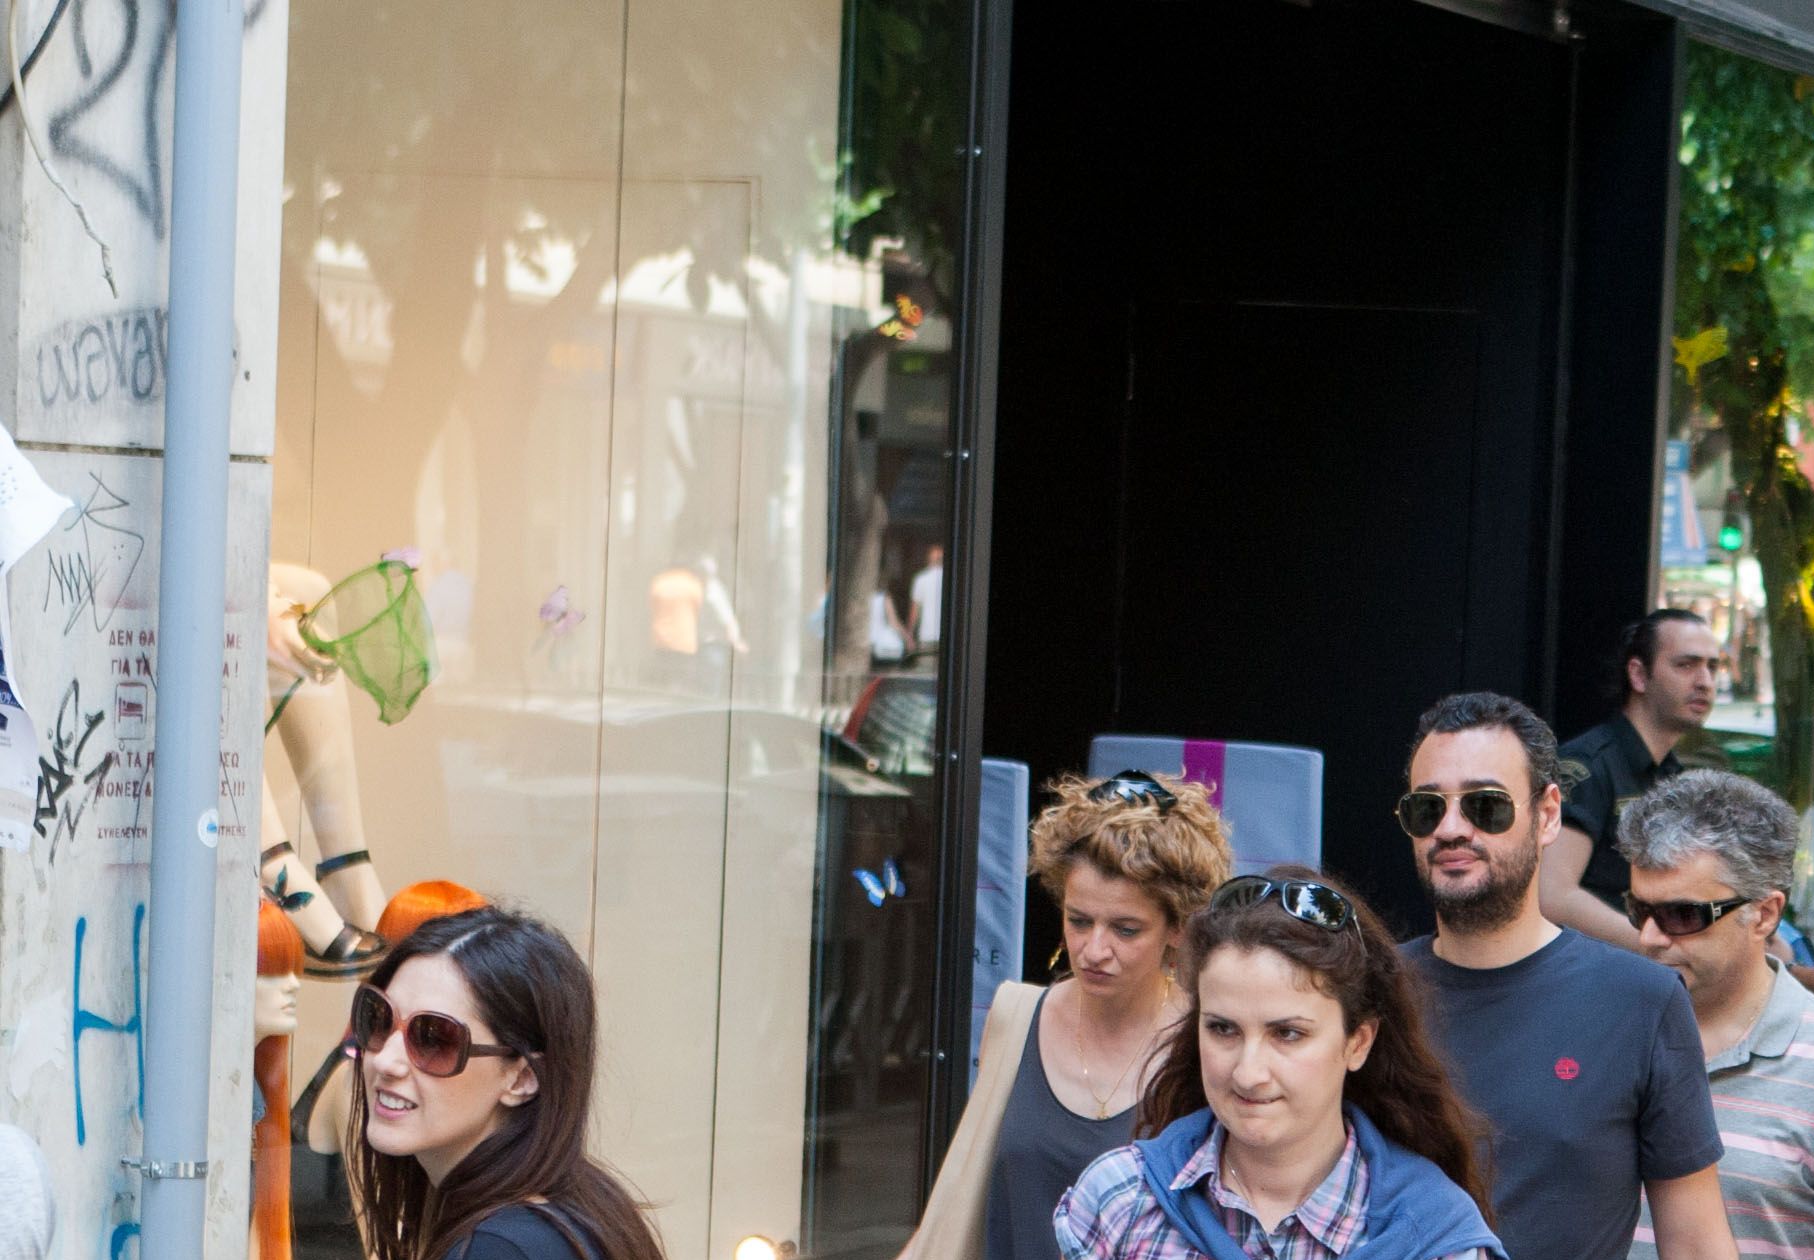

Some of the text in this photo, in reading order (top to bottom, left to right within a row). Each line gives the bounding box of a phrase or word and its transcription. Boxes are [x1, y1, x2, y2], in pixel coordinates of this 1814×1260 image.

[109, 629, 156, 647] ΔΕΝ ΘΑ
[111, 658, 130, 677] ΓΙΑ
[127, 752, 142, 768] ΤΑ
